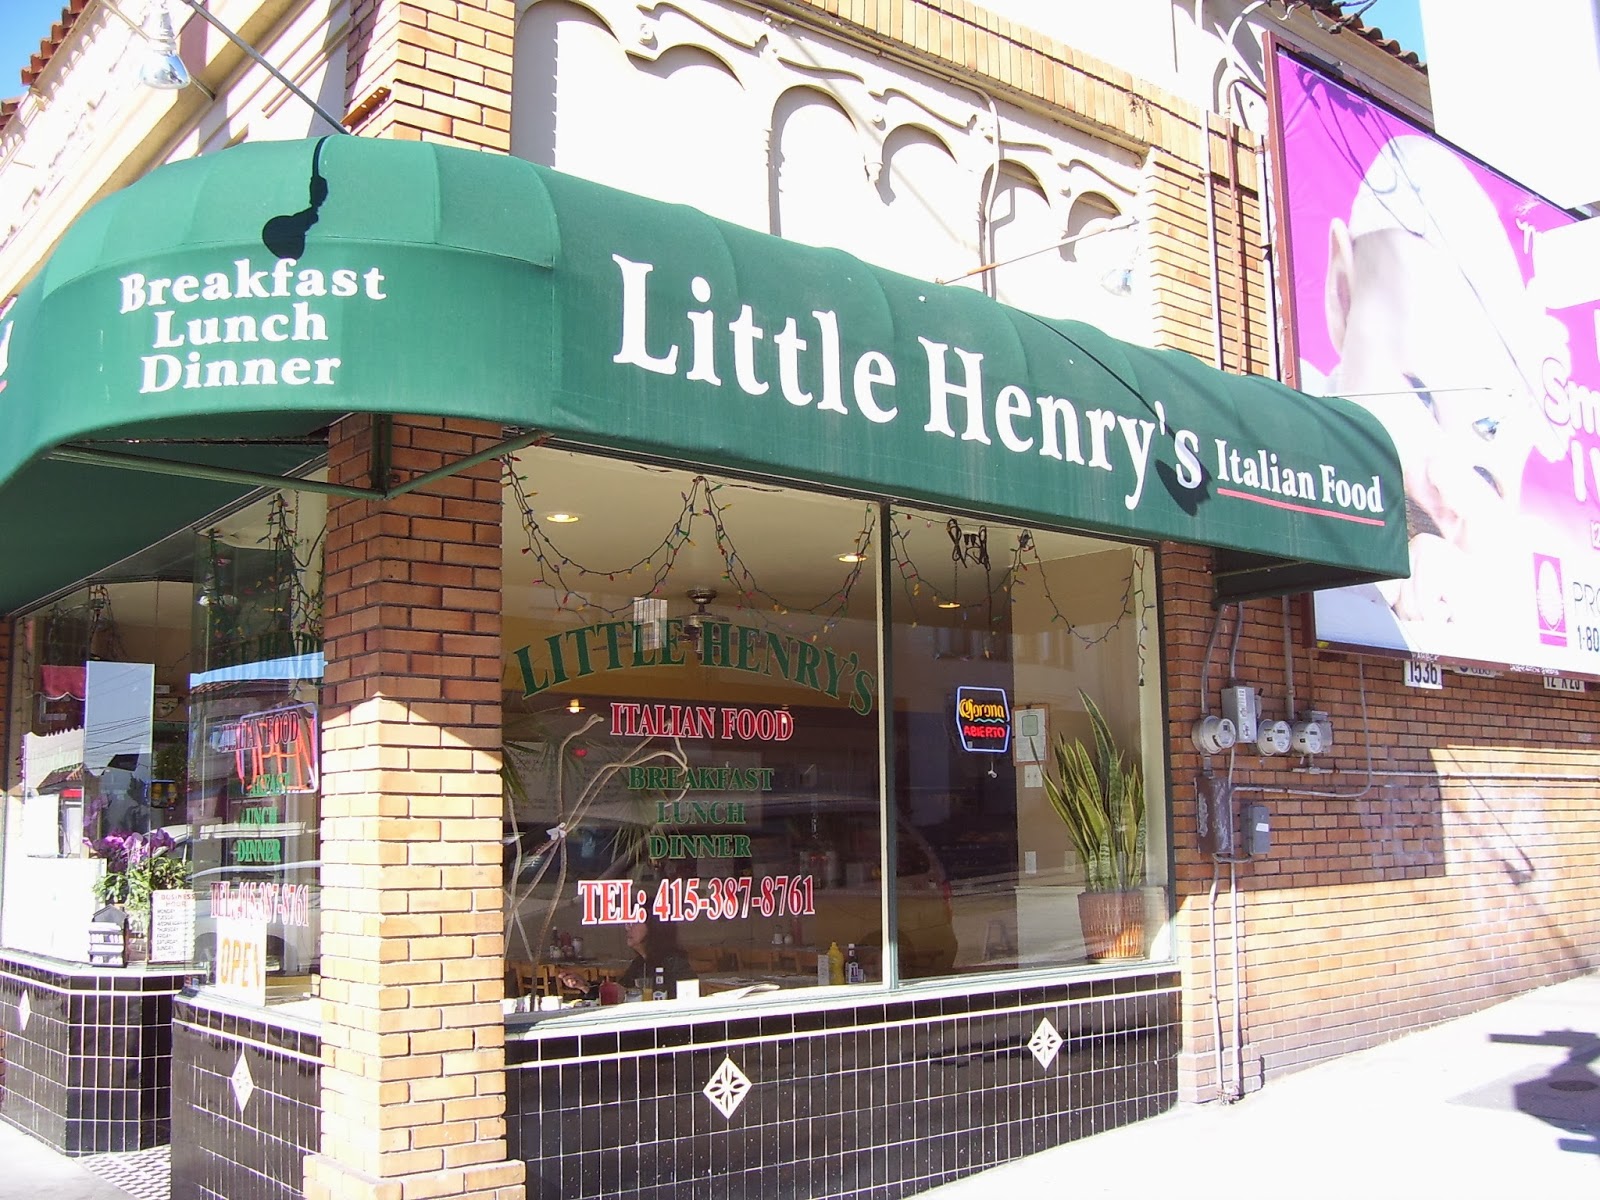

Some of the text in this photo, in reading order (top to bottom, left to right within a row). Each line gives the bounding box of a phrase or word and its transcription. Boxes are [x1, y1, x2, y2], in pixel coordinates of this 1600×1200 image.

[119, 257, 387, 315] Breakfast
[153, 302, 328, 348] Lunch
[139, 352, 341, 394] Dinner
[611, 253, 1203, 511] Little Henry's
[1214, 437, 1385, 513] Italian Food
[513, 618, 876, 716] LITTLE HENRY'S
[1410, 661, 1438, 684] 1536
[609, 702, 794, 741] ITALIAN FOOD
[959, 698, 1005, 721] Corona
[265, 711, 299, 747] FOOD
[964, 726, 1006, 738] ABIERTO
[627, 766, 775, 791] BREAKFAST
[656, 801, 746, 825] LUNCH
[237, 839, 281, 862] DINNER
[649, 834, 752, 860] DINNER
[577, 874, 816, 925] TEL: 415-387-8761
